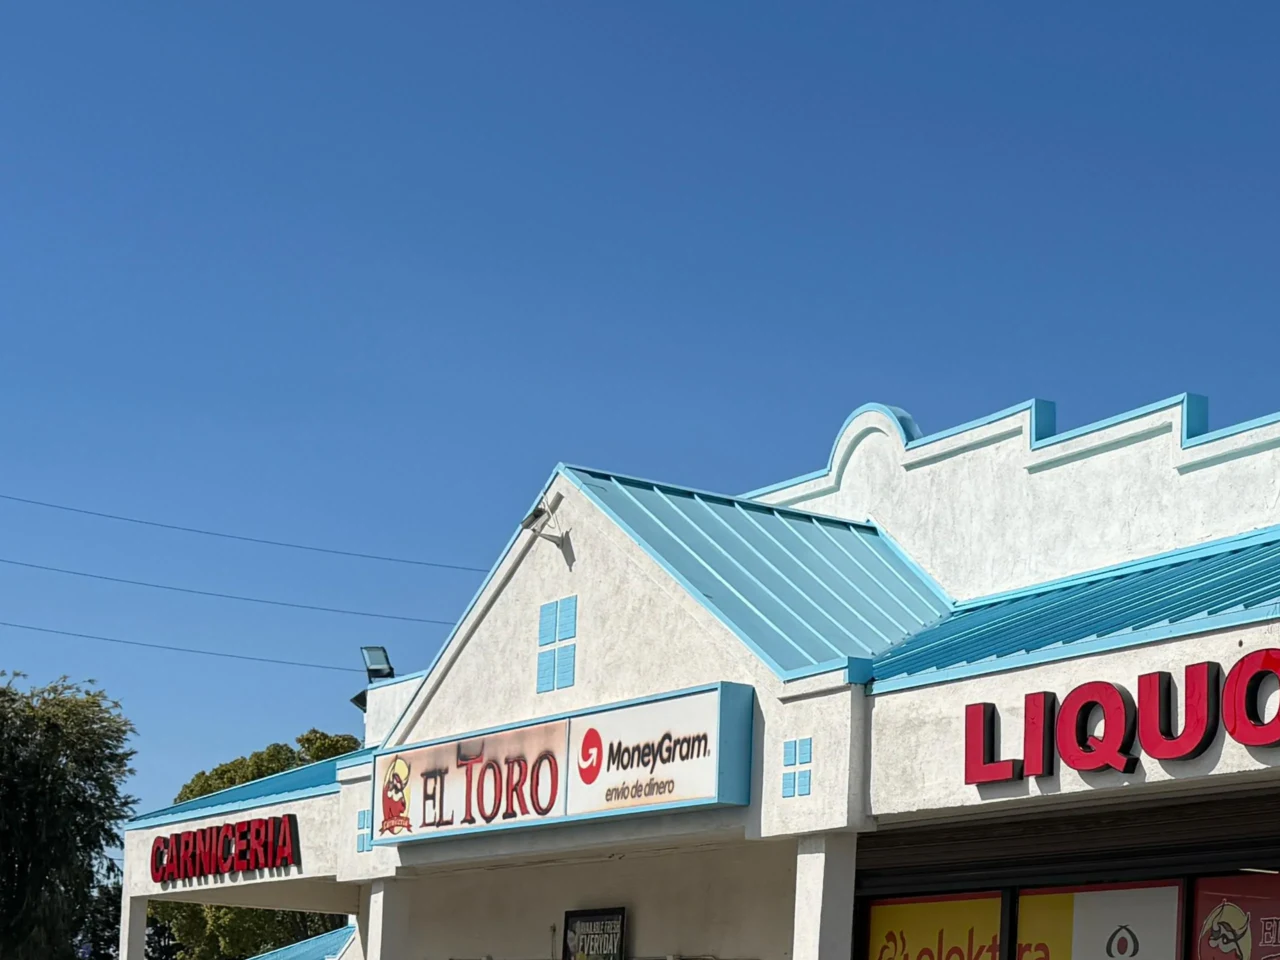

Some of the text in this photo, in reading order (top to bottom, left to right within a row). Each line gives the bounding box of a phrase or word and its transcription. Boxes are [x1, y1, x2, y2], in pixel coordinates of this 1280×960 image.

[607, 731, 709, 774] MoneyGram
[420, 740, 559, 828] EL TORO
[631, 782, 643, 797] de
[644, 778, 675, 796] dinero
[151, 814, 299, 883] CARNICERIA
[578, 934, 620, 955] EVERYDAY
